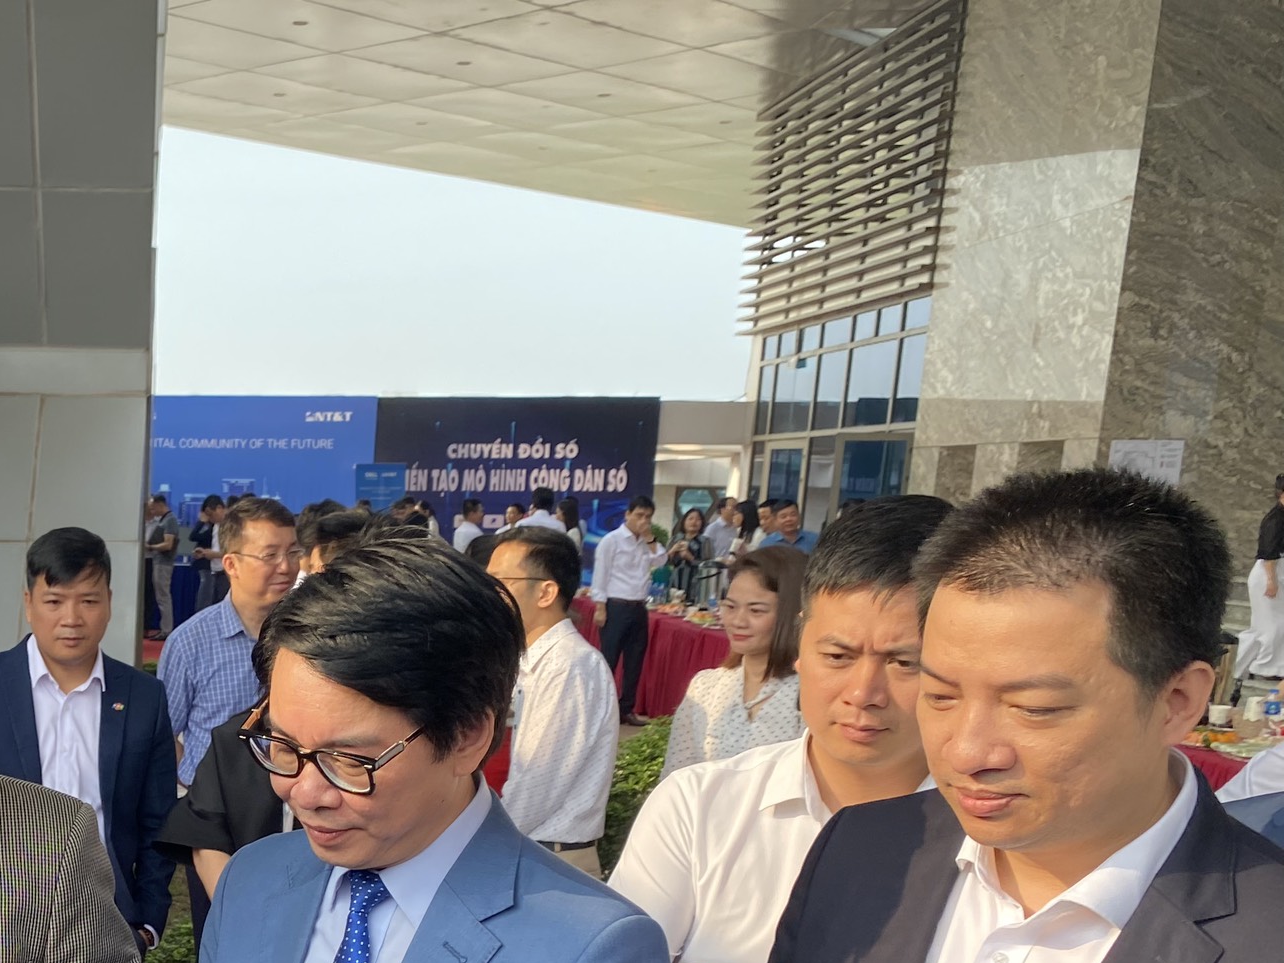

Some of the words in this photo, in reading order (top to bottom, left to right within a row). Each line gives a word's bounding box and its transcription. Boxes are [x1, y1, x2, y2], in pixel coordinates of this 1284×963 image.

[150, 438, 176, 449] ITAL
[178, 438, 247, 449] COMMUNITY
[249, 438, 265, 449] OF
[267, 438, 288, 449] THE
[290, 438, 334, 449] FUTURE
[431, 469, 459, 497] TẠO
[607, 461, 628, 492] SỐ
